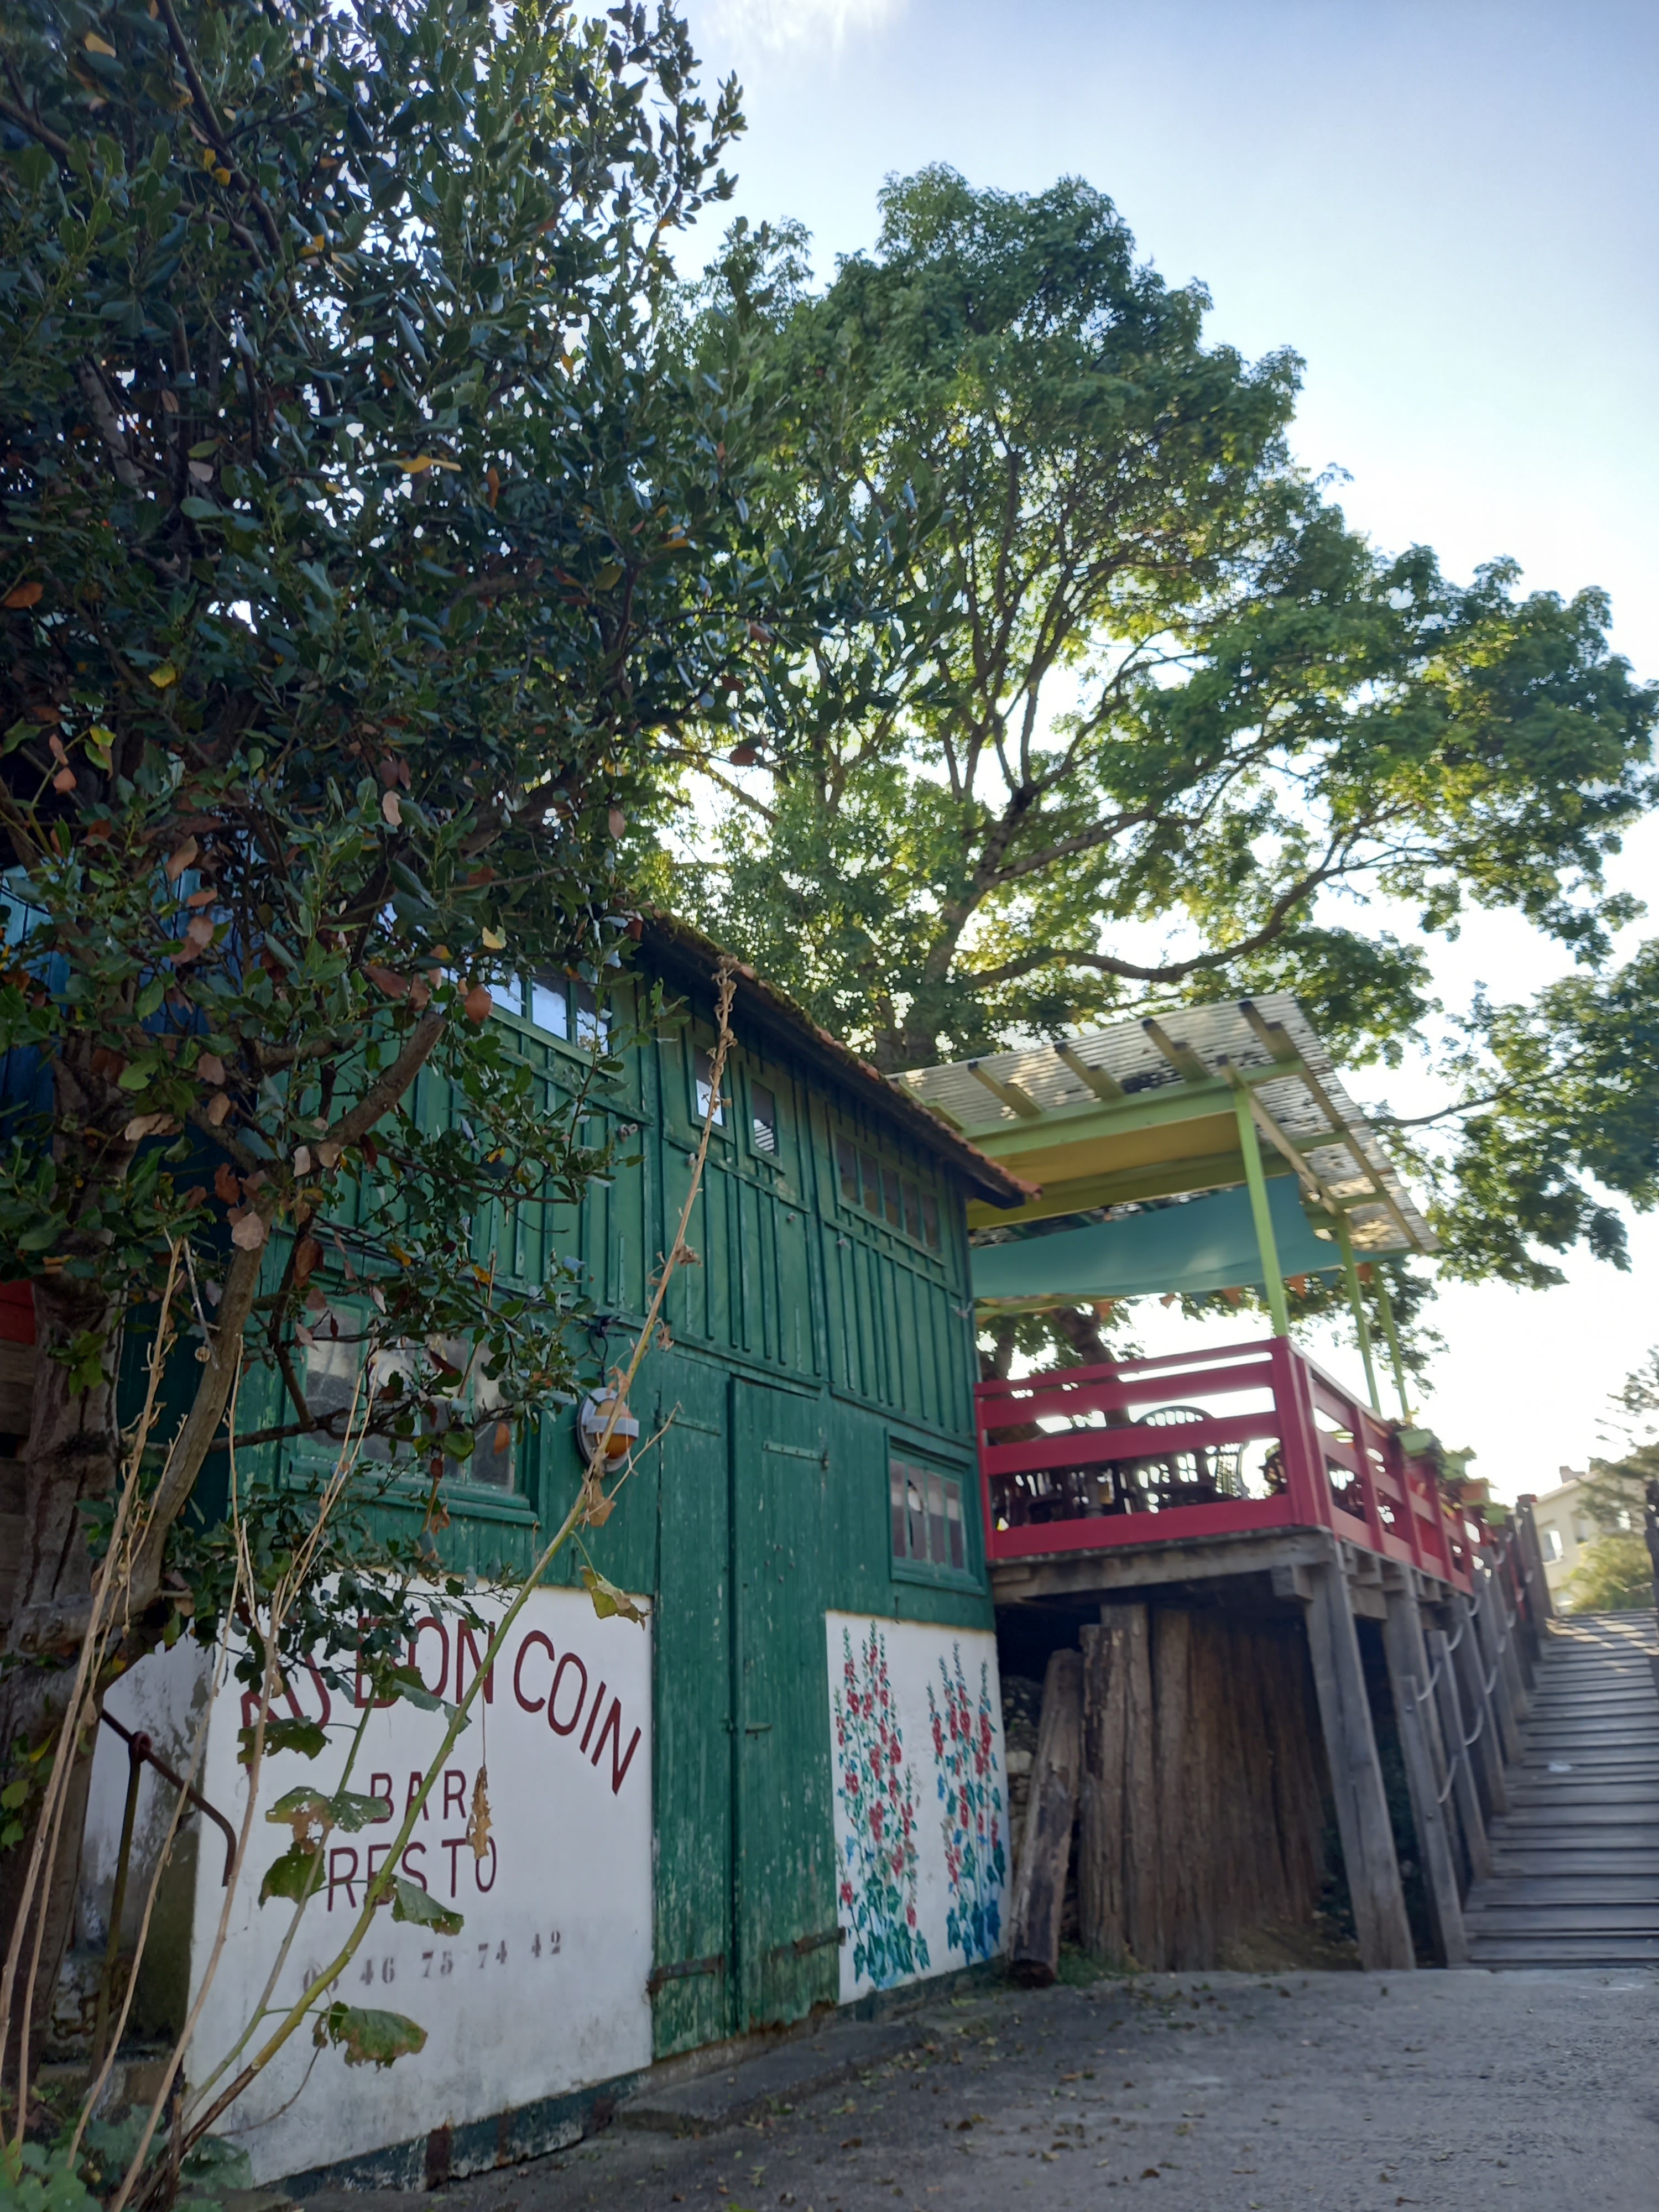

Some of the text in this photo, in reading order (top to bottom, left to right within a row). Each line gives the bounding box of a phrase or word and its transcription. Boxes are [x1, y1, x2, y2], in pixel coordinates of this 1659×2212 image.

[354, 1616, 495, 1708] BON
[514, 1630, 641, 1796] COIN
[370, 1769, 467, 1824] BAR
[327, 1835, 497, 1912] RESTO
[360, 1957, 395, 1986] 46
[422, 1950, 453, 1978] 75
[478, 1939, 508, 1969] 74
